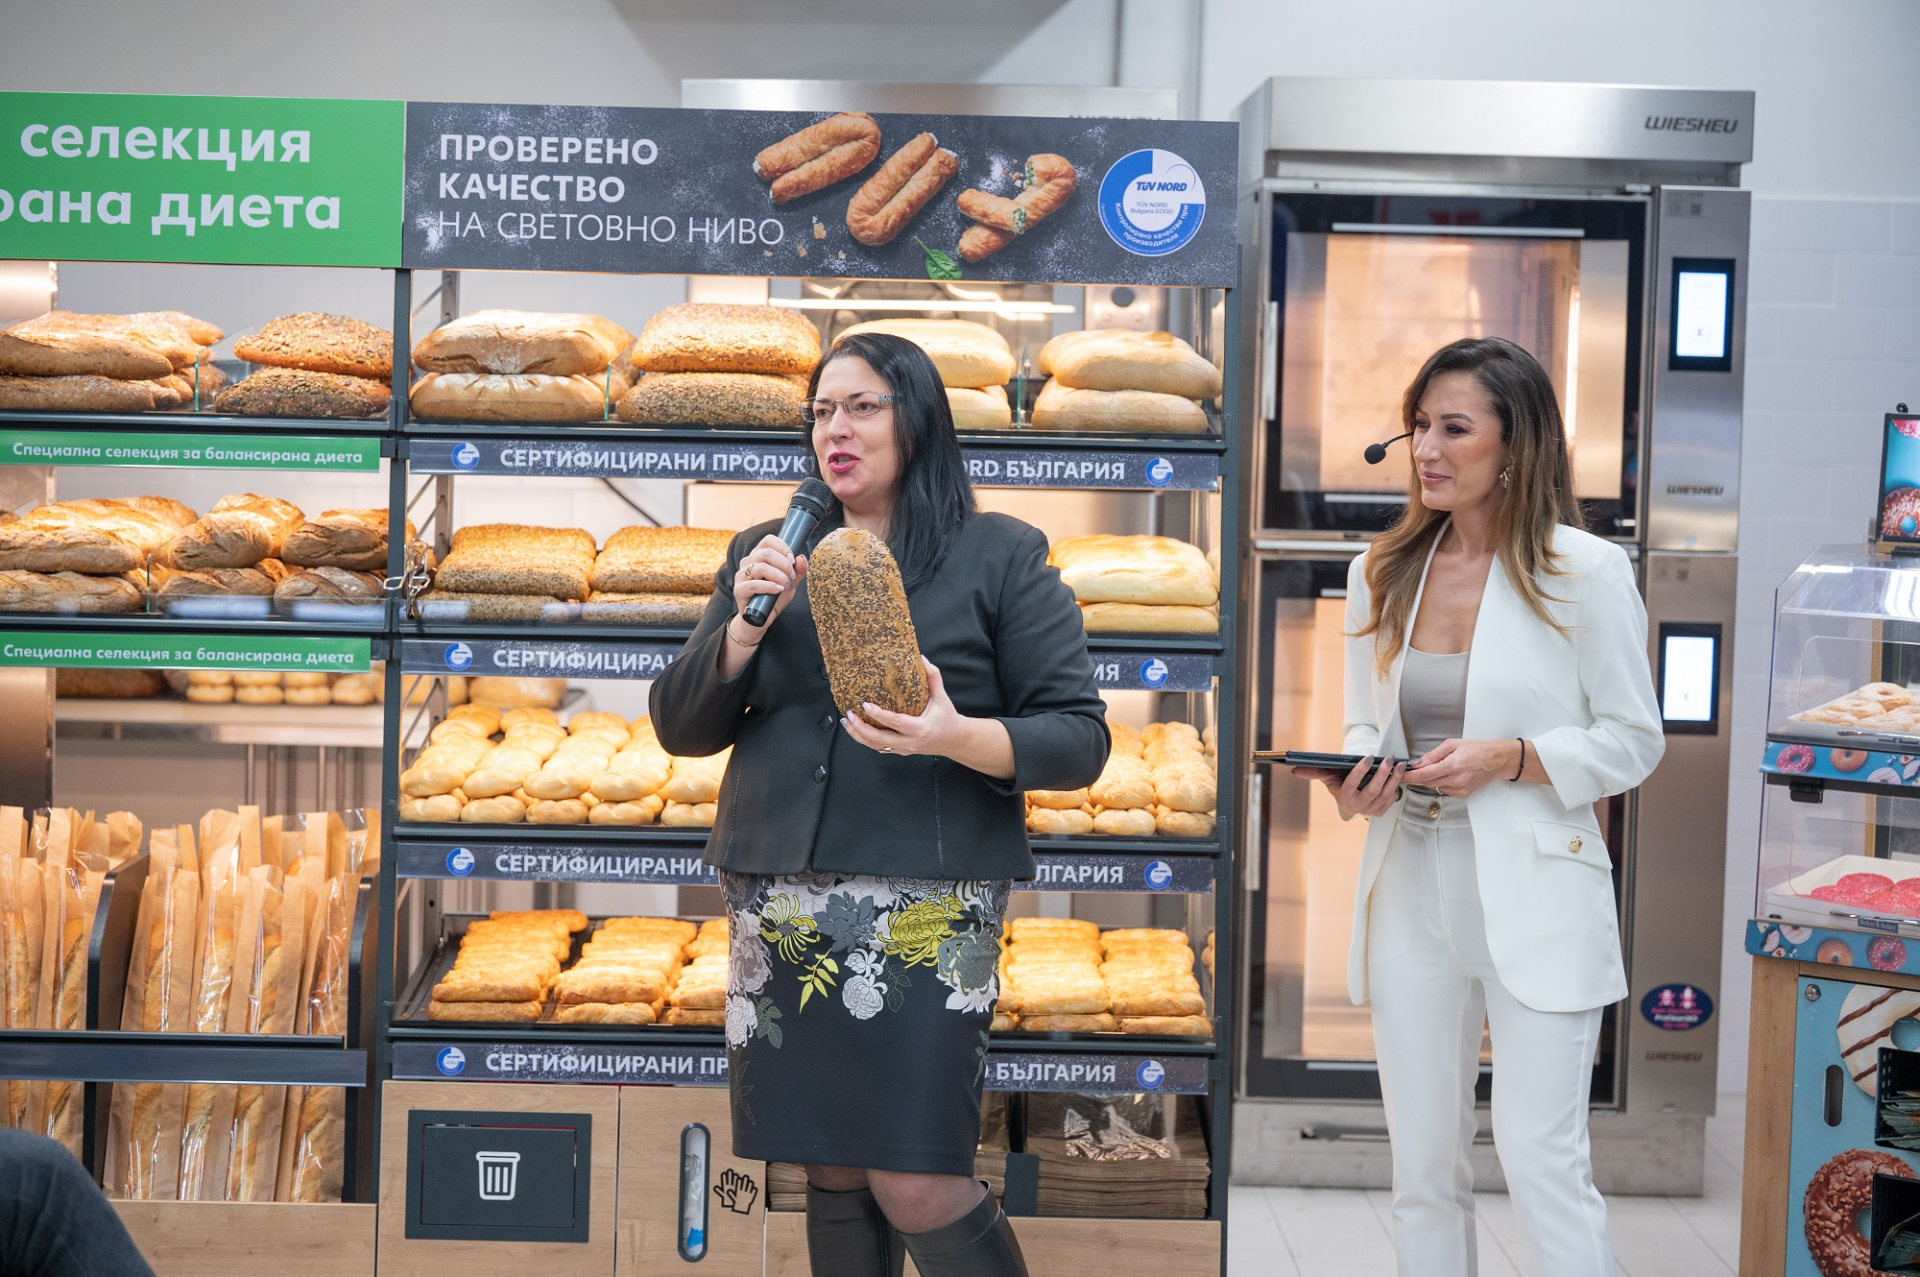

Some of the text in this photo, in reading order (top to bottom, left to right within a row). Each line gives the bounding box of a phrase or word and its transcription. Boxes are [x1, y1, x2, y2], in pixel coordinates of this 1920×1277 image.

[1644, 115, 1738, 133] WIESHEU
[20, 124, 310, 171] селекция
[440, 134, 658, 165] ПРОВЕРЕНО
[439, 173, 625, 203] КАЧЕСТВО
[1136, 181, 1187, 192] TÜV NORD
[152, 193, 340, 236] диета
[1115, 202, 1152, 240] Контролирано
[1153, 219, 1183, 239] качество
[1181, 204, 1189, 220] при
[1130, 207, 1154, 215] Bulgaria
[439, 211, 784, 245] НА СВЕТОВНО НИВО
[1123, 231, 1179, 247] производителя
[13, 442, 362, 465] Специална селекция за балансирана диета
[500, 449, 815, 475] СЕРТИФИЦИРАНИ ПРОДУК
[1006, 460, 1125, 479] БЪЛГАРИЯ
[4, 644, 354, 665] Специална селекция за балансирана диета
[495, 854, 701, 877] СЕРТИФИЦИРАНИ
[486, 1053, 692, 1076] СЕРТИФИЦИРАНИ
[997, 1063, 1116, 1082] БЪЛГАРИЯ
